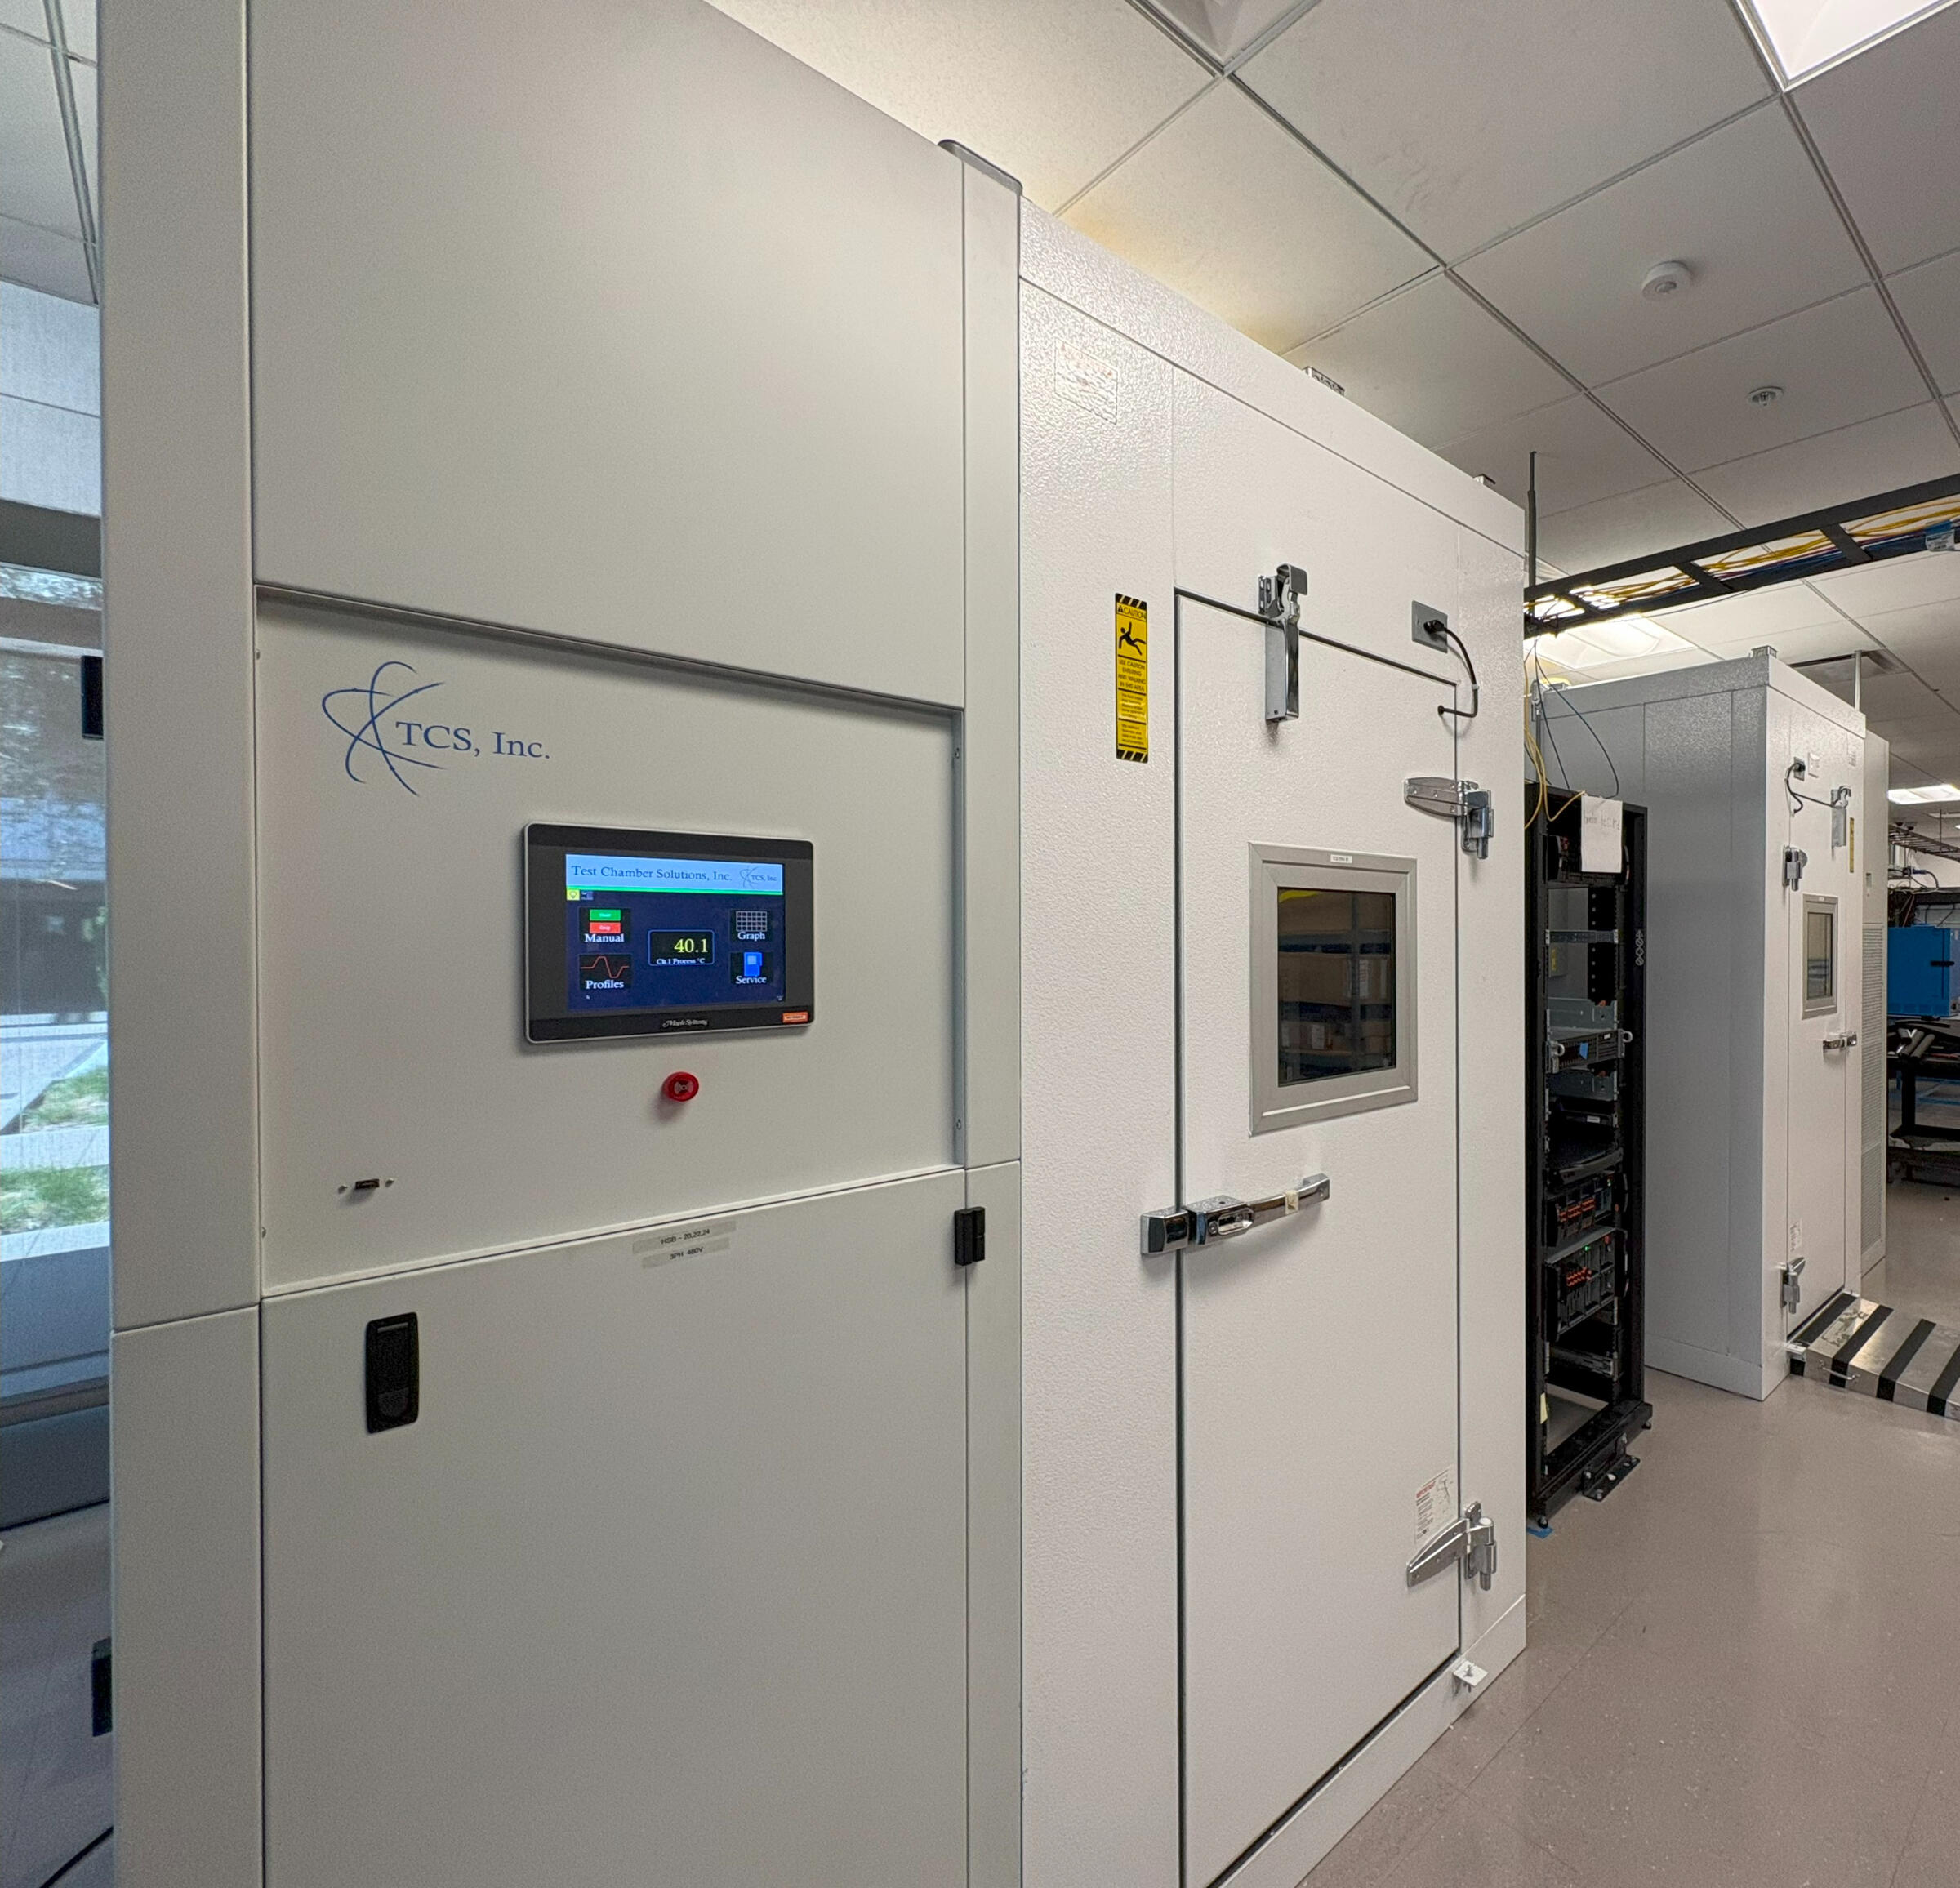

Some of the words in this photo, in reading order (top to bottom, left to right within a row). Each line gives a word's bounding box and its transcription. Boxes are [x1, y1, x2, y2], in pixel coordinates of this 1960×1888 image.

[1123, 606, 1147, 620] CAUTION
[395, 721, 480, 757] TCS,
[492, 731, 550, 759] Inc.
[571, 865, 597, 876] Test
[600, 866, 653, 879] Chamber
[656, 867, 710, 881] Solutions,
[713, 871, 733, 881] Inc.
[584, 933, 625, 942] Manual
[737, 931, 766, 942] Graph
[674, 938, 708, 953] 40.1
[586, 979, 625, 990] Profiles
[735, 975, 767, 985] Service
